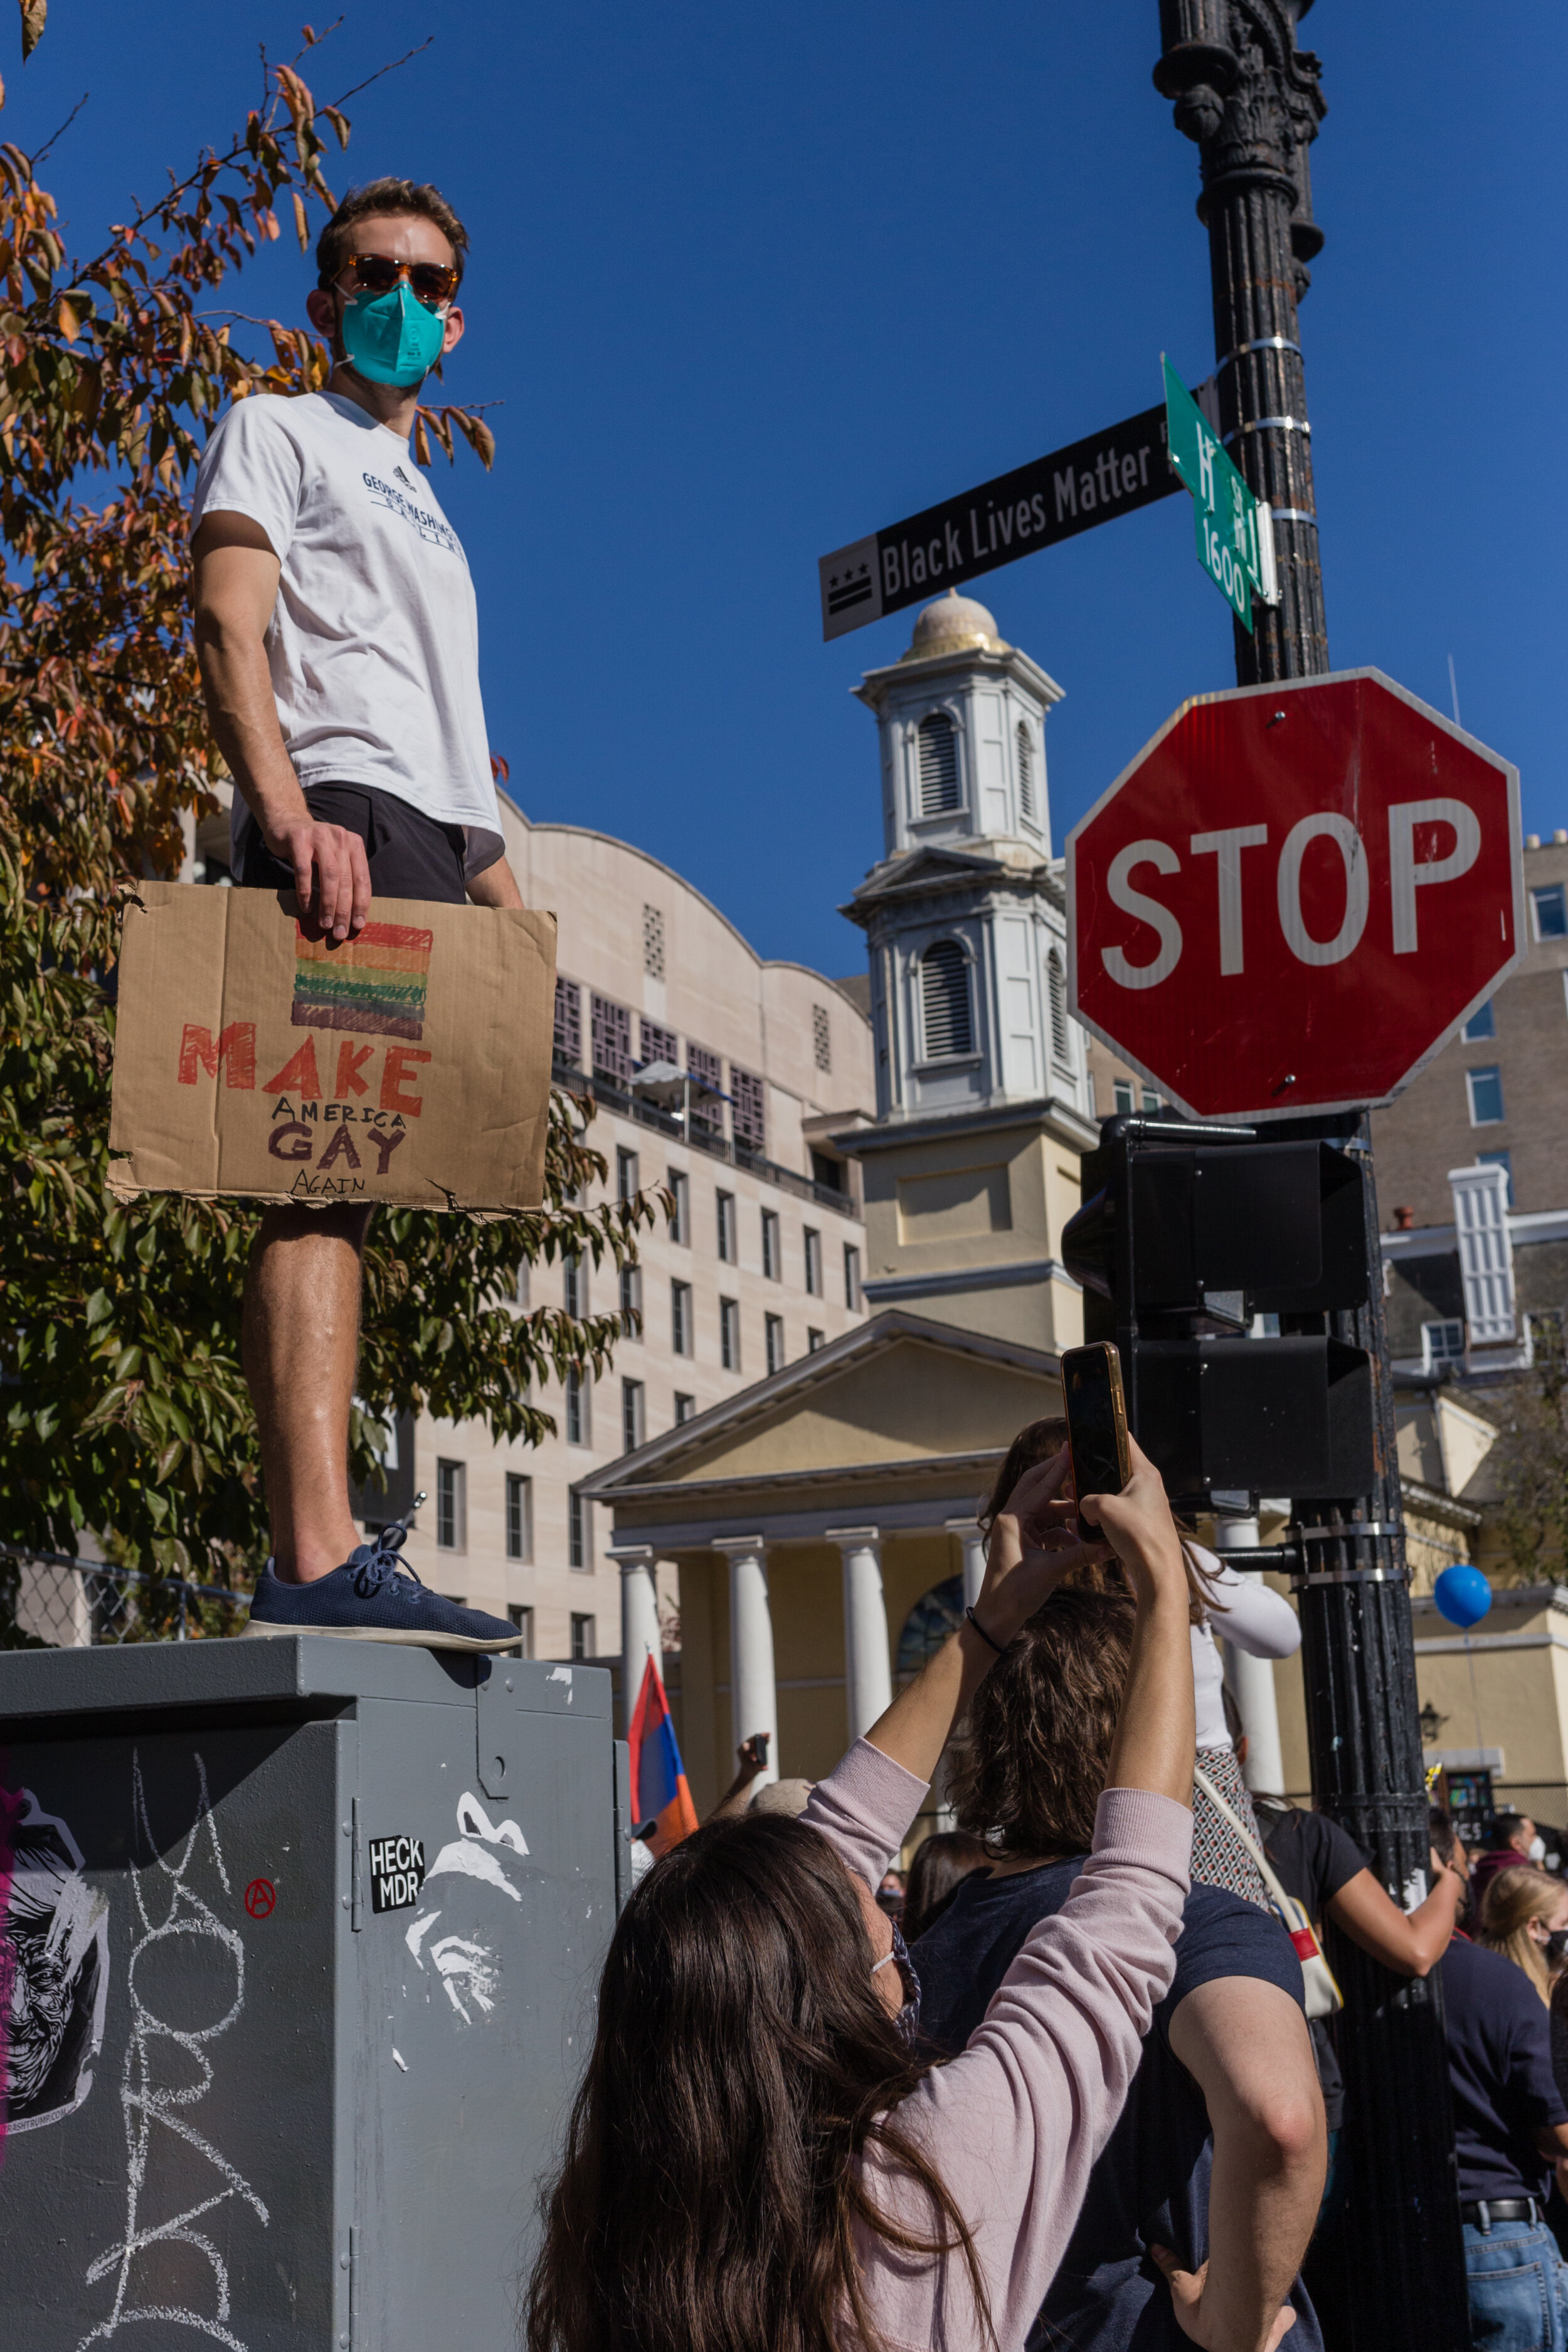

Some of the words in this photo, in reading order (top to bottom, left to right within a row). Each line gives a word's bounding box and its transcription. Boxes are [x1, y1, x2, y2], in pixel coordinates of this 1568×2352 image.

[363, 472, 406, 508] GEORGE
[1195, 420, 1215, 513] H
[882, 519, 963, 597] Black
[970, 492, 1046, 558] Lives
[1054, 446, 1150, 522] Matter
[1203, 518, 1244, 613] 1600
[1101, 797, 1481, 990] STOP
[177, 1021, 432, 1117] MAKE
[271, 1096, 406, 1129] AMERICA
[268, 1122, 406, 1175] GAY
[289, 1169, 366, 1194] AGAIN
[371, 1838, 423, 1875] HECK
[379, 1872, 419, 1908] MDR
